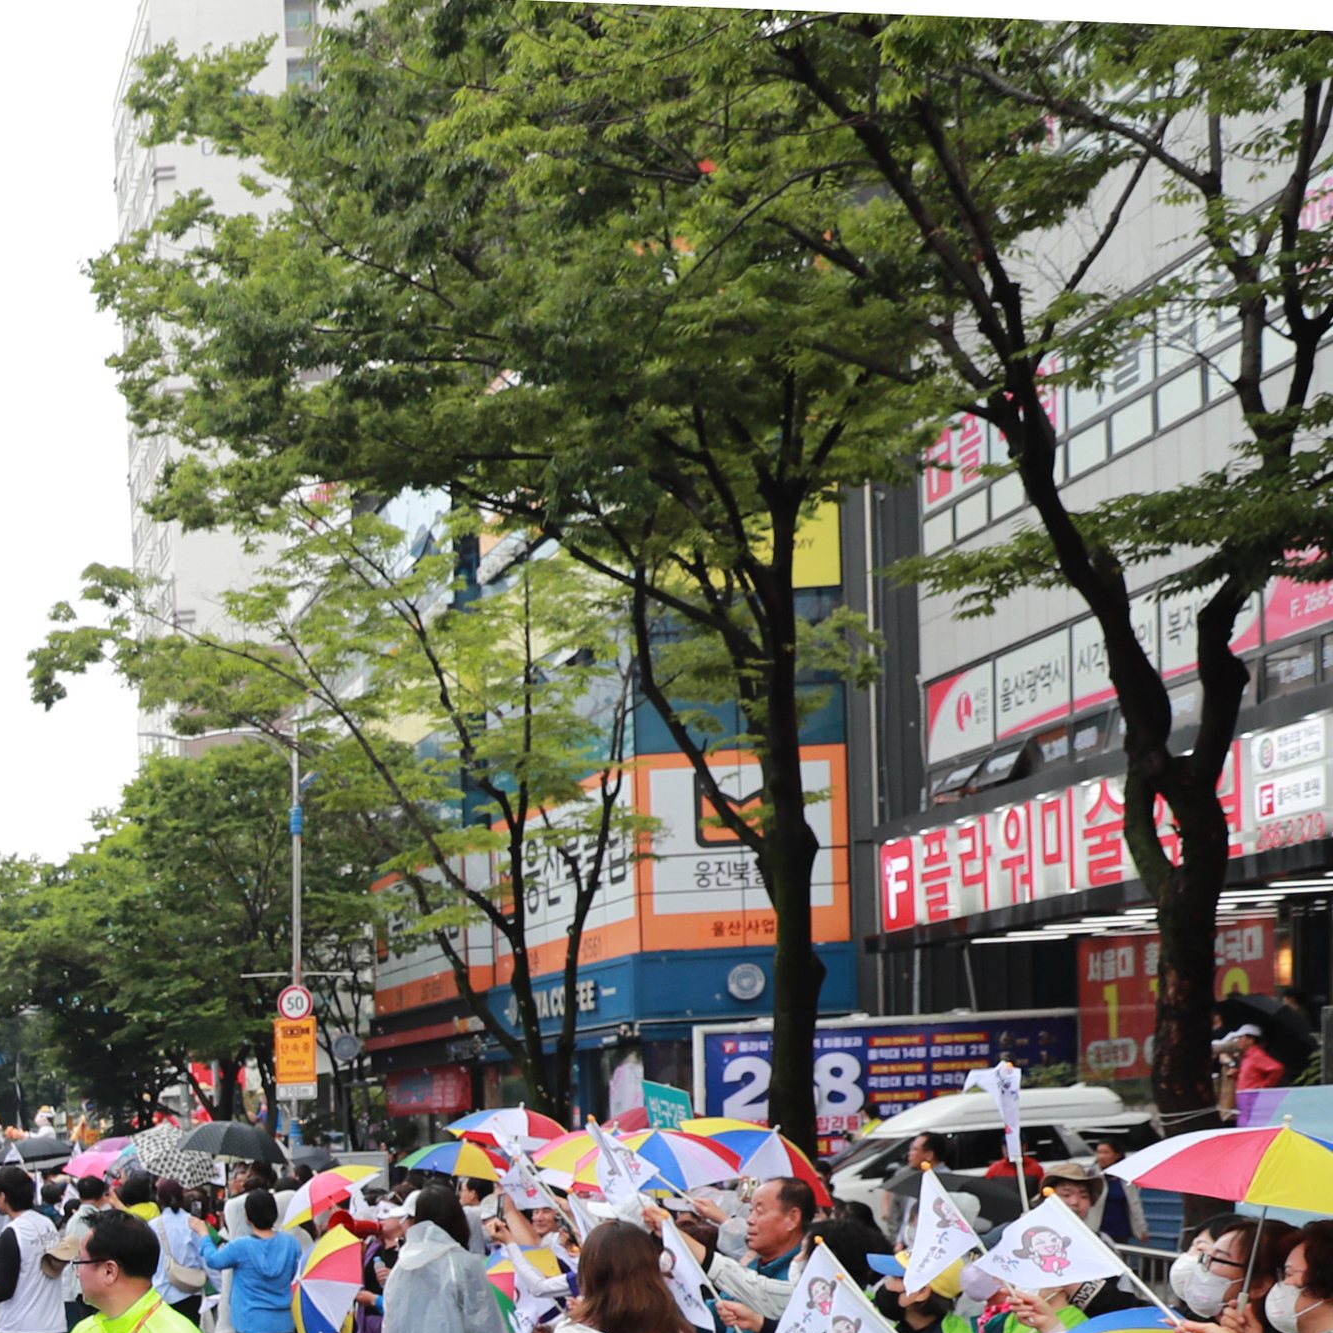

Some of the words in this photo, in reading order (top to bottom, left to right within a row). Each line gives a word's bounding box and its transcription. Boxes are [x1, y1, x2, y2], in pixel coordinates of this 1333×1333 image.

[999, 655, 1066, 714] 울산광역시
[711, 921, 742, 938] 울산
[745, 918, 776, 936] 사업
[1087, 945, 1136, 982] 서울대
[286, 996, 304, 1012] 50
